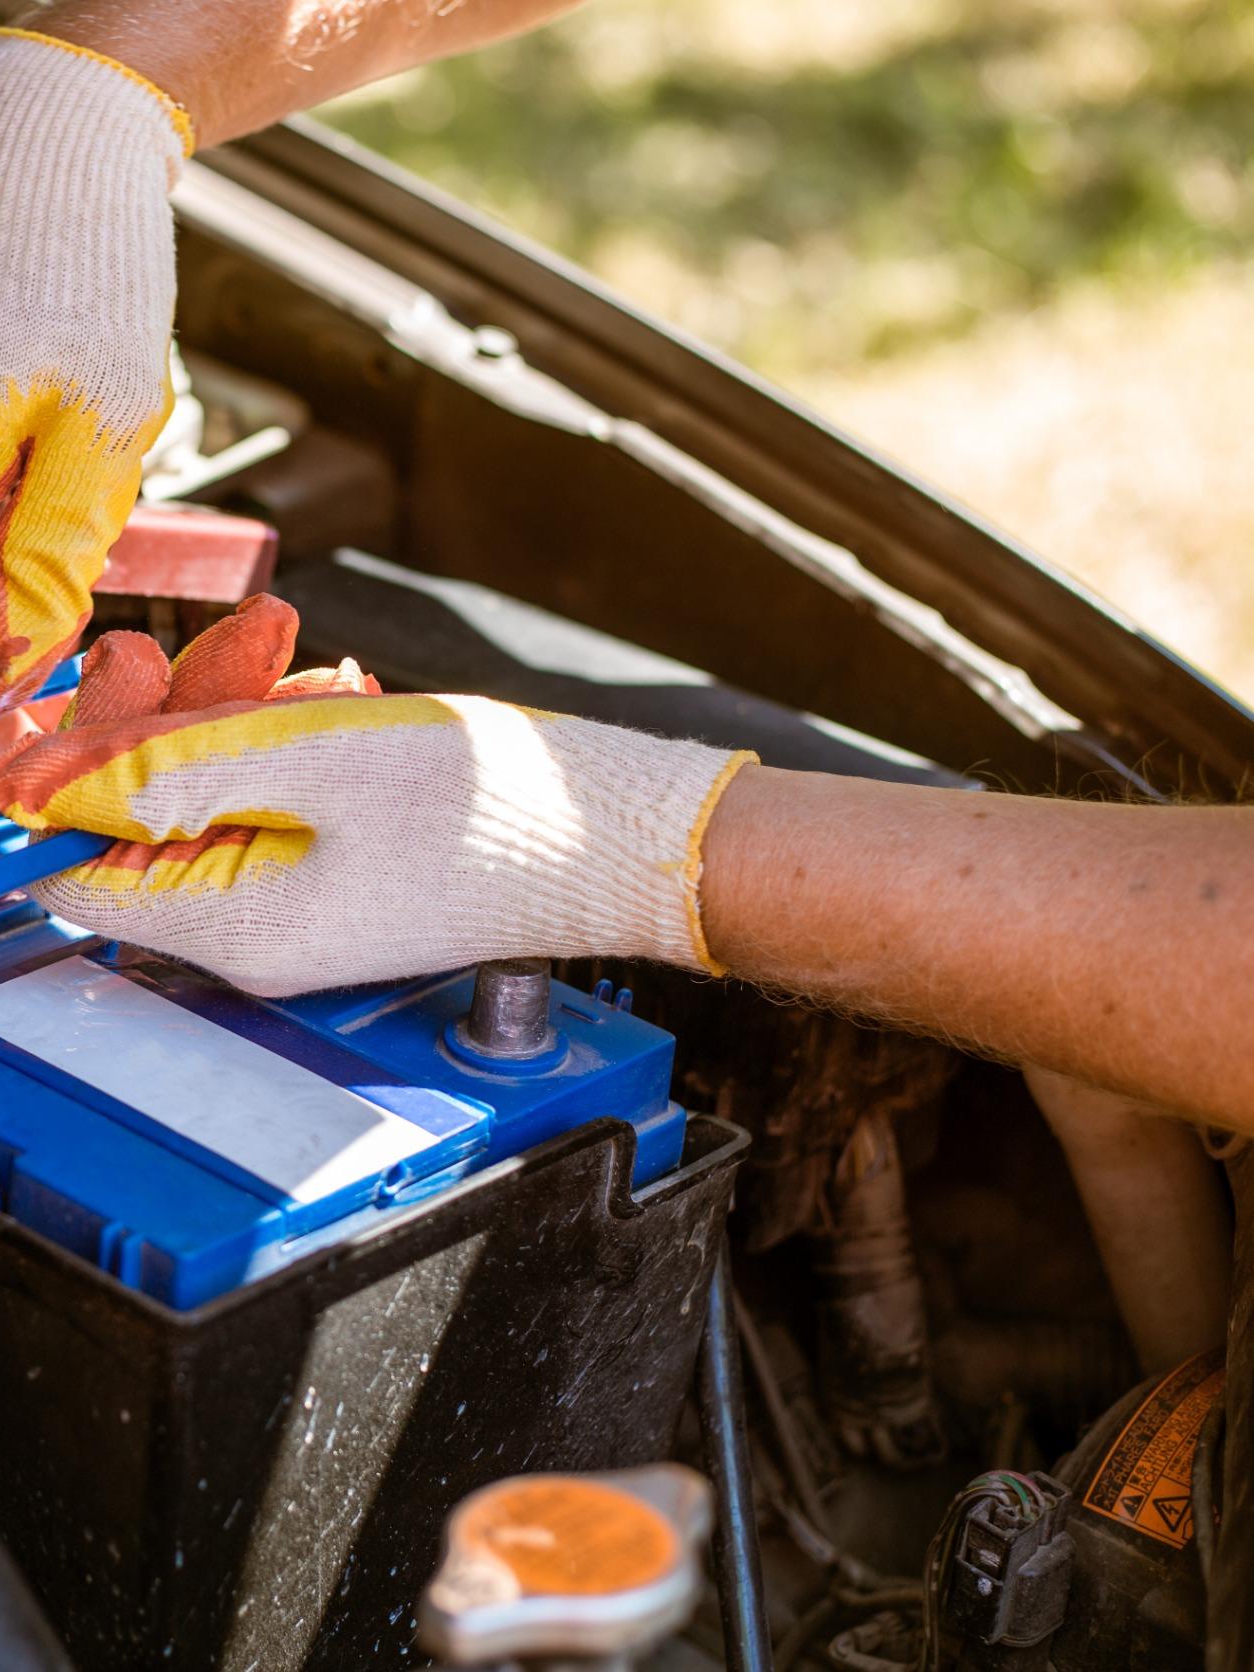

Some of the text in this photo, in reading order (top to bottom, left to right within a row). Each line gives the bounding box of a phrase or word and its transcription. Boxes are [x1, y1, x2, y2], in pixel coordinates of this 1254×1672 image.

[1113, 1439, 1148, 1485] PHARES
[1143, 1407, 1170, 1438] FARO
[1120, 1399, 1161, 1452] HEADLAMP
[1142, 1417, 1180, 1463] WARNING
[1140, 1441, 1178, 1491] ACHTUNG
